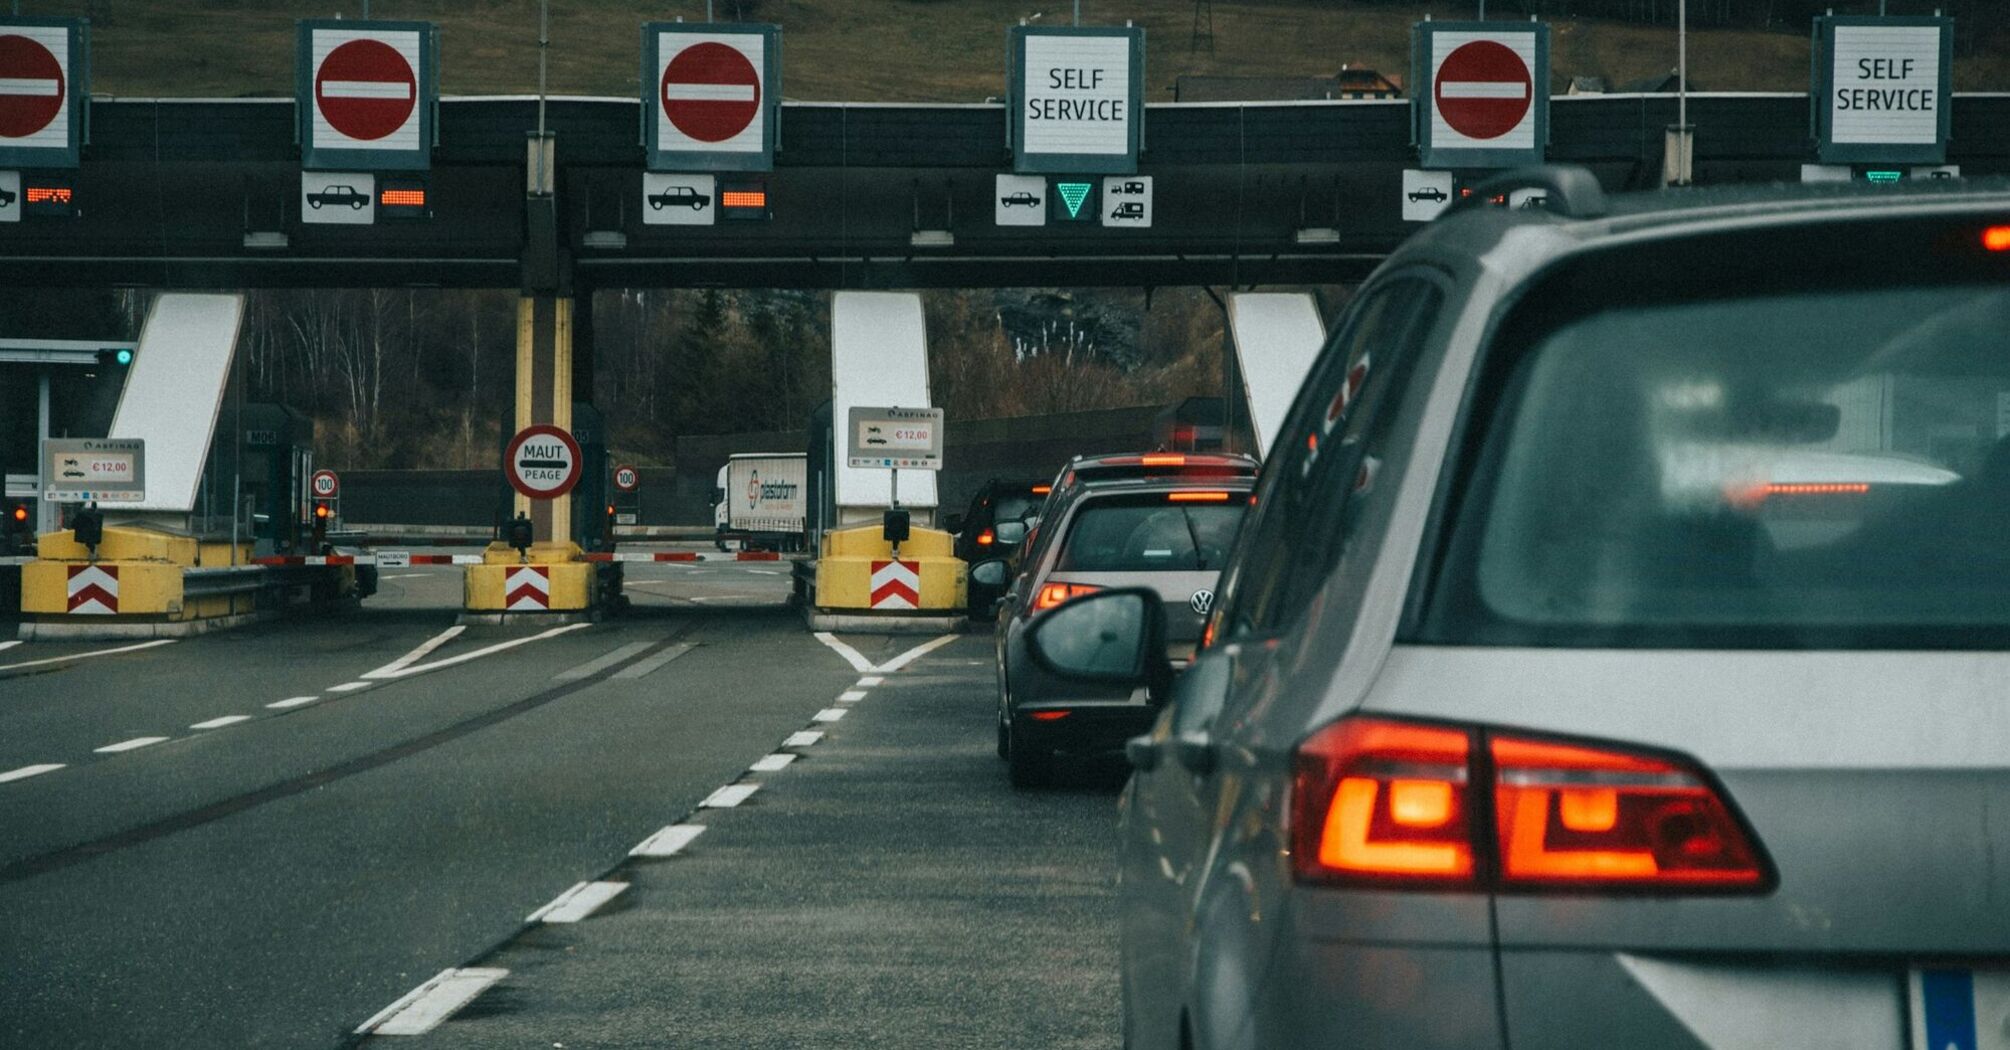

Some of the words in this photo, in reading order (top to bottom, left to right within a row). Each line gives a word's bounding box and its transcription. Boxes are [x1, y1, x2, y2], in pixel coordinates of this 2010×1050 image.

[1857, 58, 1914, 79] SELF
[1049, 68, 1104, 89] SELF
[1837, 88, 1933, 110] SERVICE
[1029, 98, 1123, 120] SERVICE
[524, 445, 563, 459] MAUT
[525, 470, 560, 480] PEAGE
[619, 473, 634, 484] 100
[318, 479, 333, 491] 100
